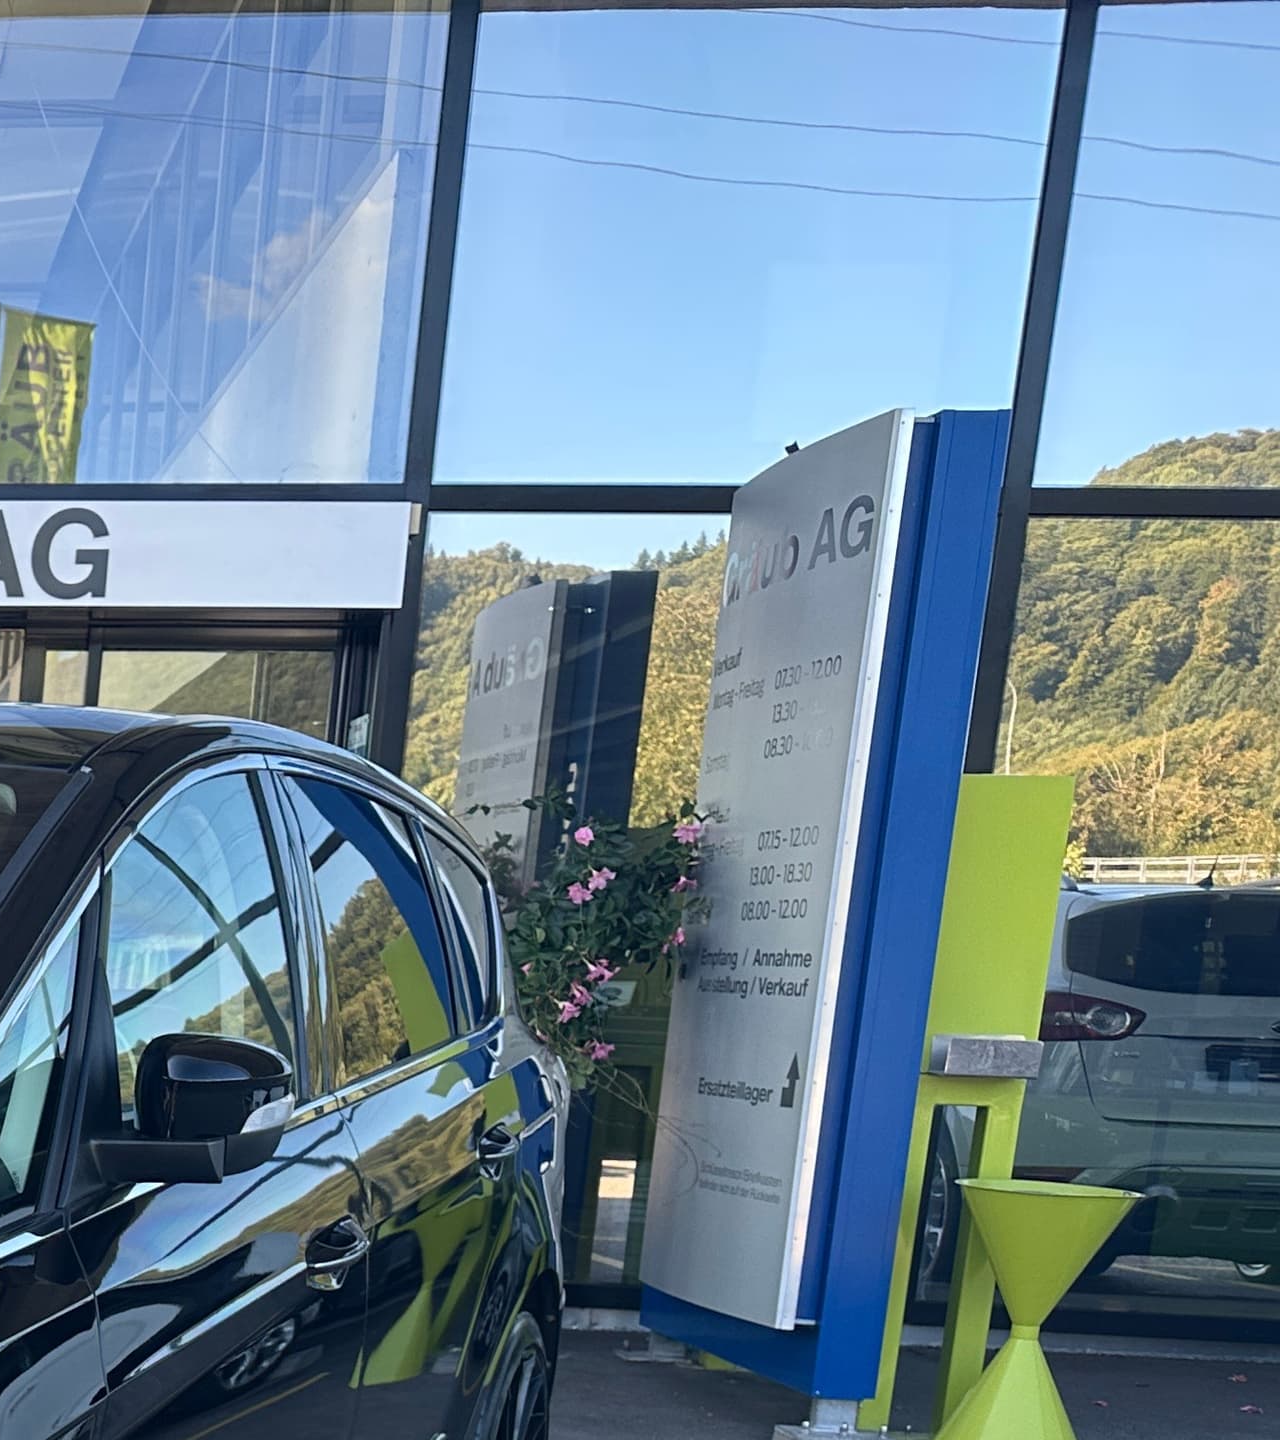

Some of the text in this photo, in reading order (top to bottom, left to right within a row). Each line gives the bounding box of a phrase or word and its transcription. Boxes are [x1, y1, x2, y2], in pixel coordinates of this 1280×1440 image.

[0, 342, 49, 484] RÄUB
[807, 494, 876, 571] AG
[789, 825, 820, 848] 12.00
[749, 865, 775, 886] 13.00
[783, 861, 813, 883] 18.30
[741, 900, 770, 921] 08.00
[778, 898, 808, 919] 12.00
[700, 949, 739, 970] Empfang
[752, 948, 813, 968] Annahme
[758, 977, 809, 997] Verkauf
